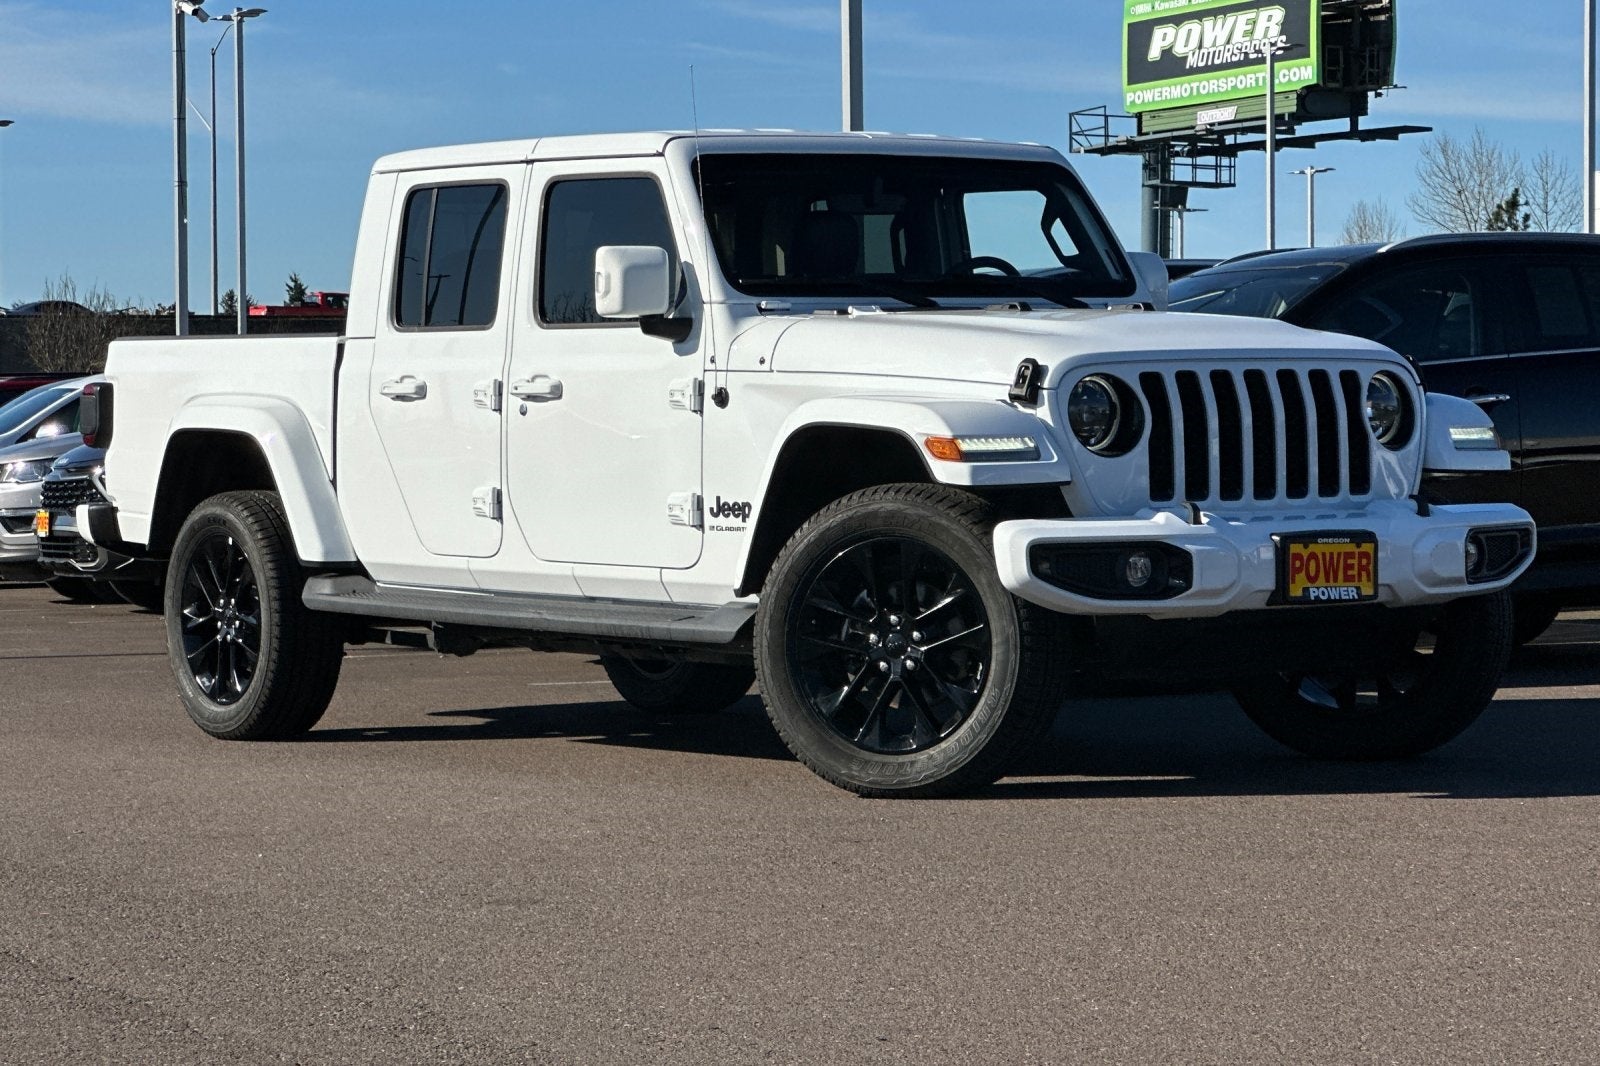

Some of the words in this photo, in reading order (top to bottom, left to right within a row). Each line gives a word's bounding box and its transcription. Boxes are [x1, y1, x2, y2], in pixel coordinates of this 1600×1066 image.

[1148, 5, 1285, 61] POWER
[1126, 66, 1313, 105] POWERMOTORSPORT.COM
[709, 496, 752, 523] Jeep
[1290, 551, 1372, 584] POWER
[1309, 587, 1358, 600] POWER
